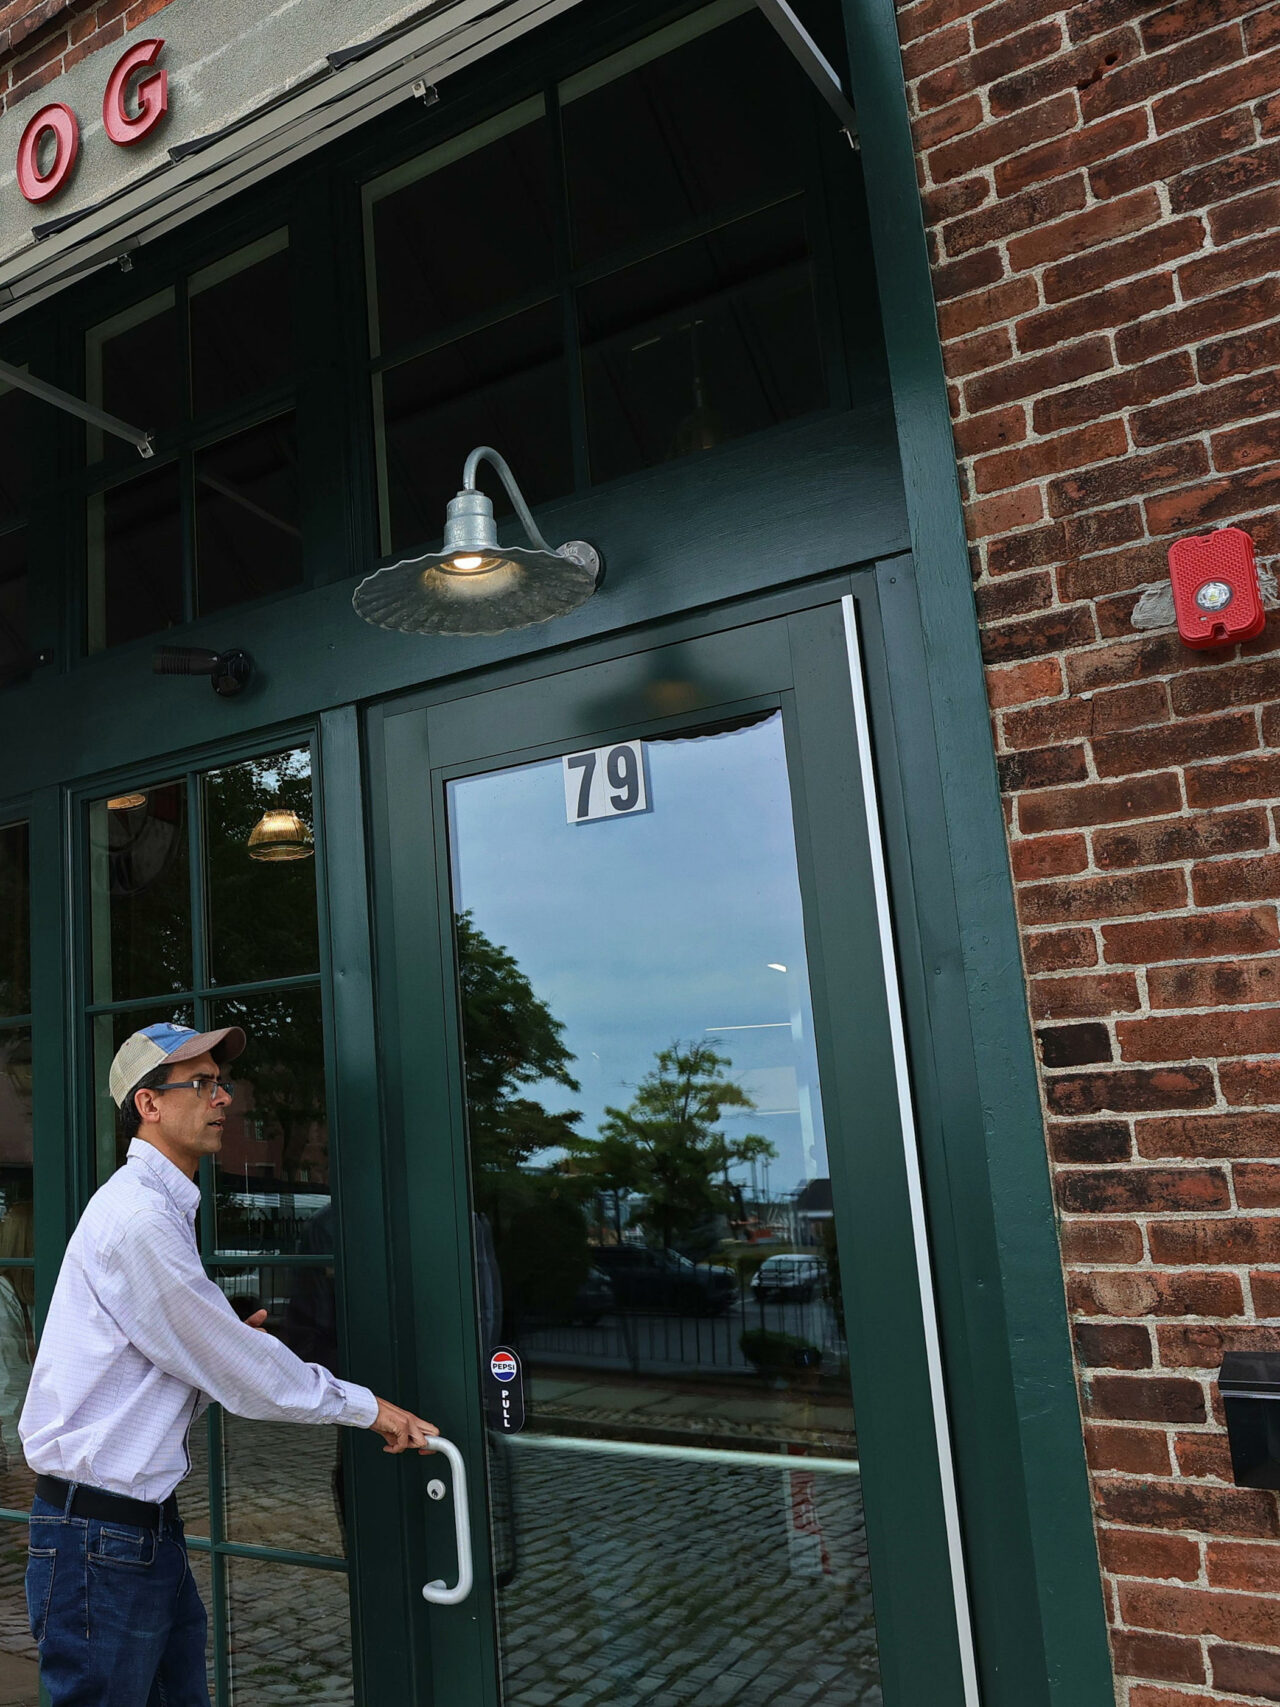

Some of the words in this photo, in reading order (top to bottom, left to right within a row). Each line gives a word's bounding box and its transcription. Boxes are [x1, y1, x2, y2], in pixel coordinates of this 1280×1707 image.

[567, 745, 639, 818] 79
[492, 1363, 515, 1371] PEPSI
[501, 1389, 510, 1428] PULL
